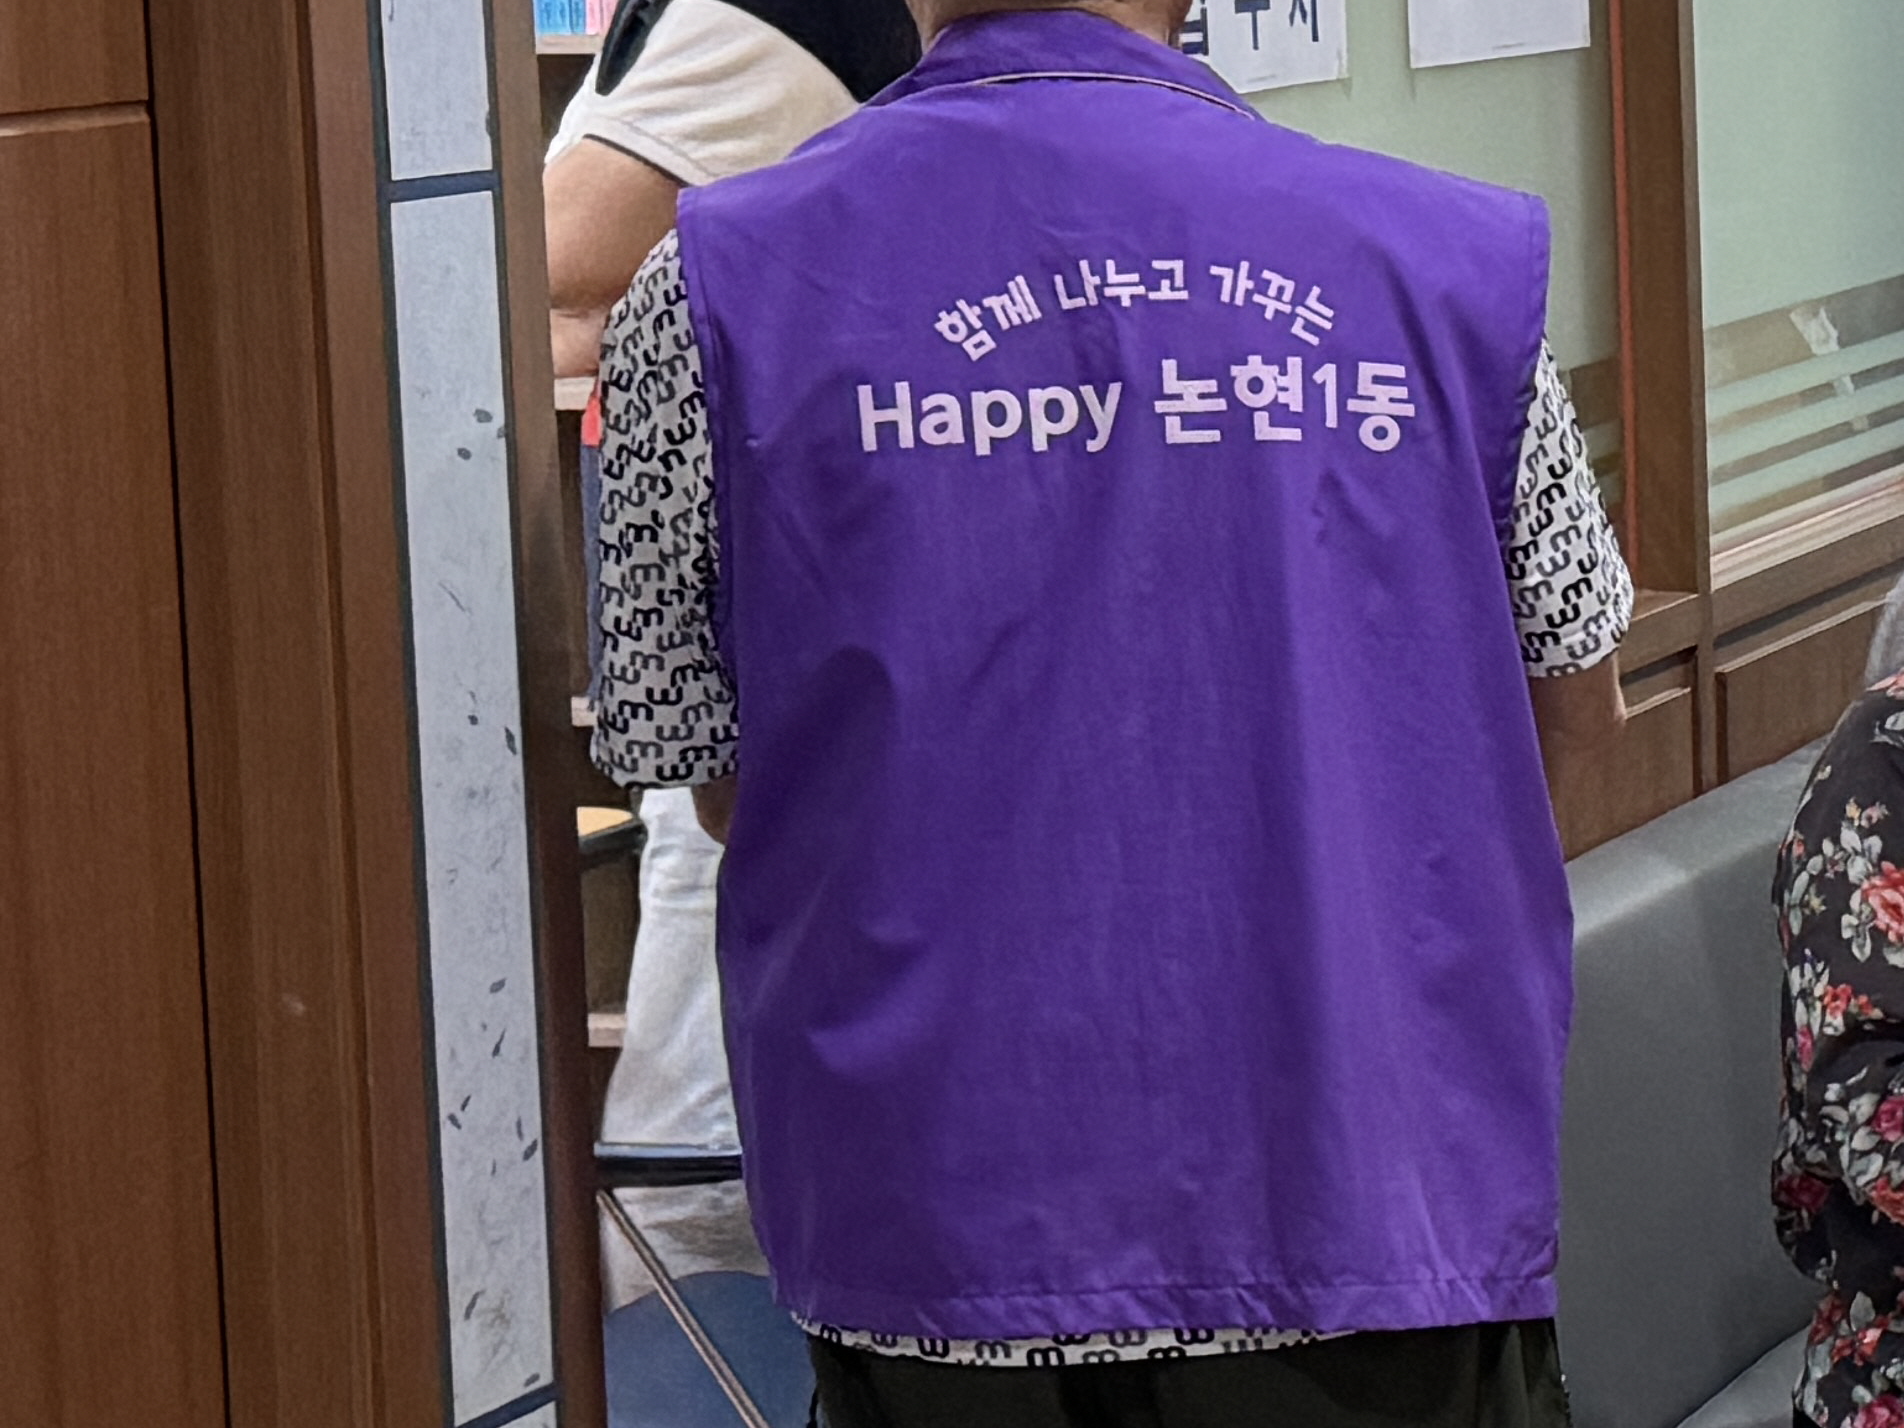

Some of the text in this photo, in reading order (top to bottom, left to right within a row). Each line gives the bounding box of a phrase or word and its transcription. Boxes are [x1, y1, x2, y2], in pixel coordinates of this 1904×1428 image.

[933, 258, 1335, 361] 함께 나누고 가꾸는
[857, 354, 1415, 456] Happy 논현1동
